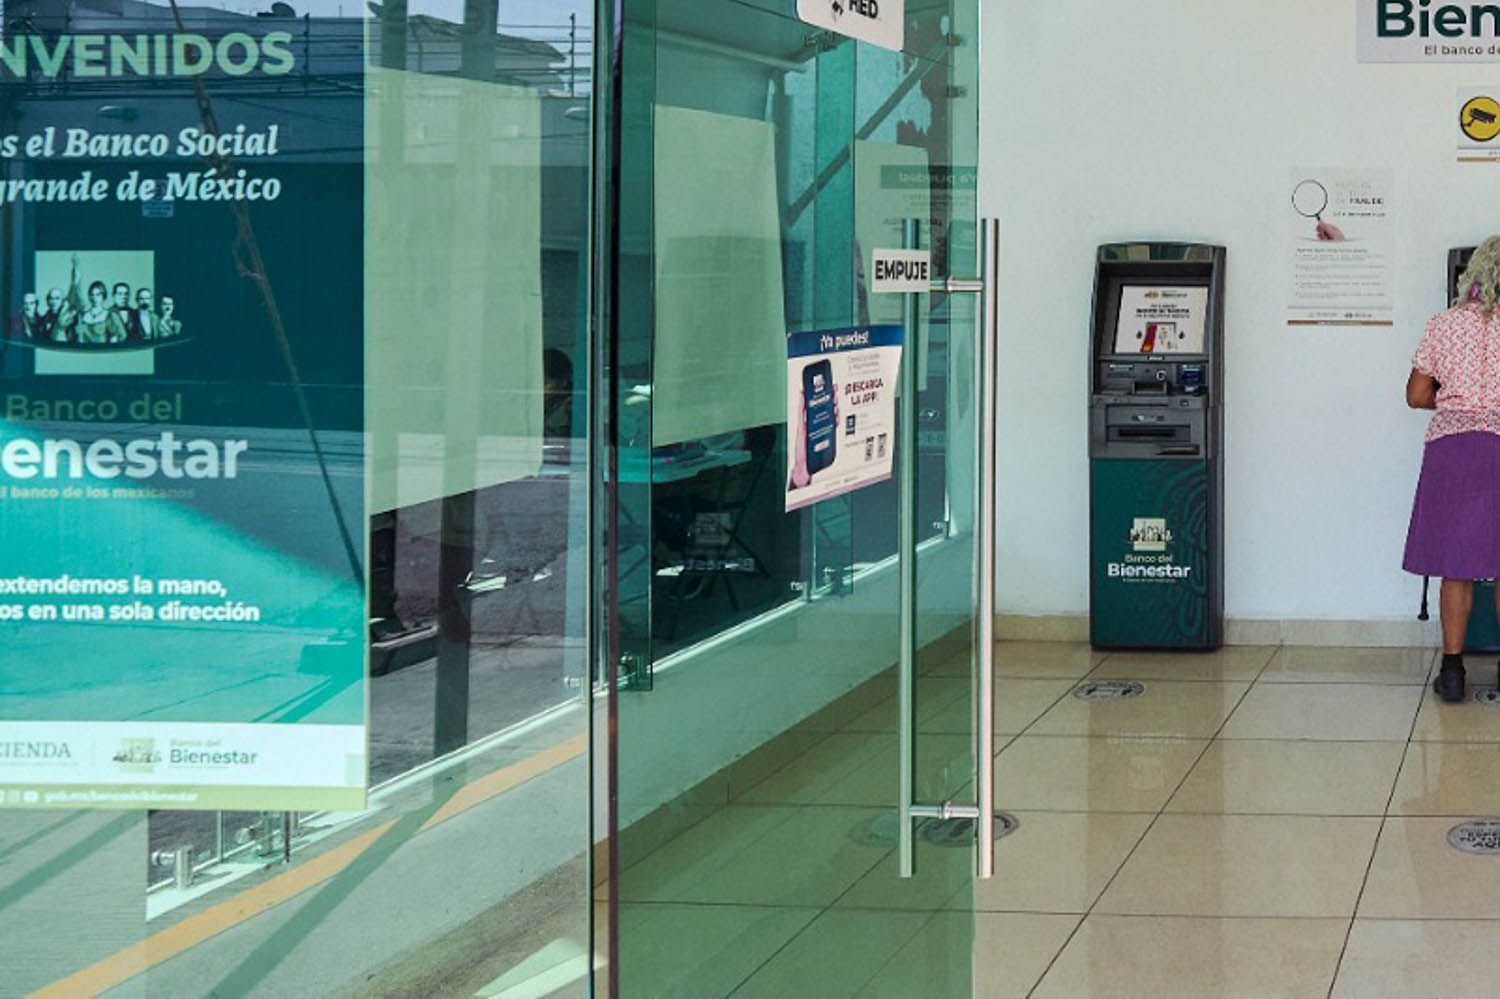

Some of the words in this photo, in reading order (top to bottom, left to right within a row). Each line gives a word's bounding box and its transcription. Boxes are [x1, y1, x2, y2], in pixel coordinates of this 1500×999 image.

[0, 32, 295, 77] NVENIDOS
[1425, 45, 1437, 56] El
[1441, 44, 1483, 56] banco
[26, 126, 55, 157] el
[62, 128, 168, 157] Banco
[177, 125, 279, 157] Social
[116, 171, 155, 201] de
[163, 169, 282, 201] México
[875, 259, 928, 281] EMPUJE
[7, 394, 118, 420] Banco
[129, 393, 181, 420] del
[0, 432, 248, 479] enestar
[11, 486, 59, 498] banco
[63, 486, 82, 498] de
[86, 486, 110, 498] los
[112, 486, 196, 498] mexicanos
[1108, 563, 1191, 578] Bienestar
[133, 575, 153, 594] la
[158, 578, 228, 597] mano,
[28, 604, 57, 620] en
[62, 604, 103, 620] una
[109, 601, 154, 620] sola
[158, 601, 260, 622] dirección
[0, 742, 72, 759] IENDA
[170, 749, 258, 765] Bienestar
